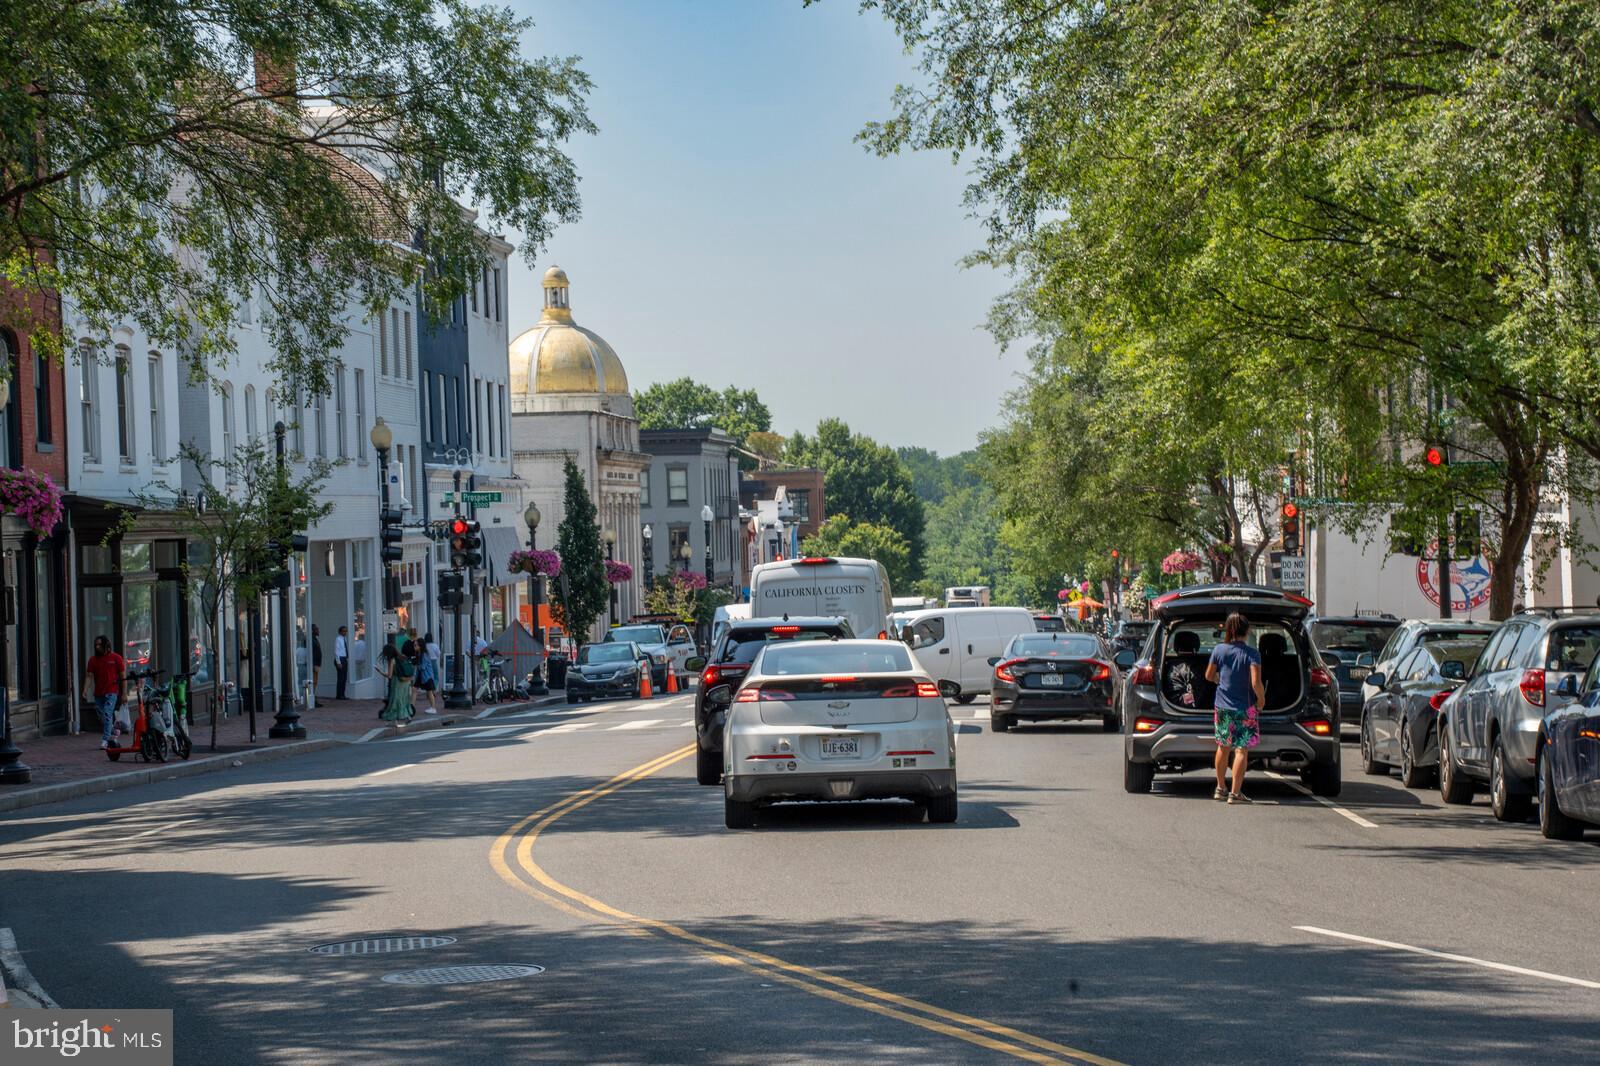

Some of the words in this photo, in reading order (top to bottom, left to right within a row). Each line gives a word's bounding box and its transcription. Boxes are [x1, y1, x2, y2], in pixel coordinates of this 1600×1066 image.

[463, 493, 491, 502] Prospect
[1282, 560, 1292, 569] DO
[765, 587, 822, 598] CALIFORNIA
[824, 584, 865, 595] CLOSETS
